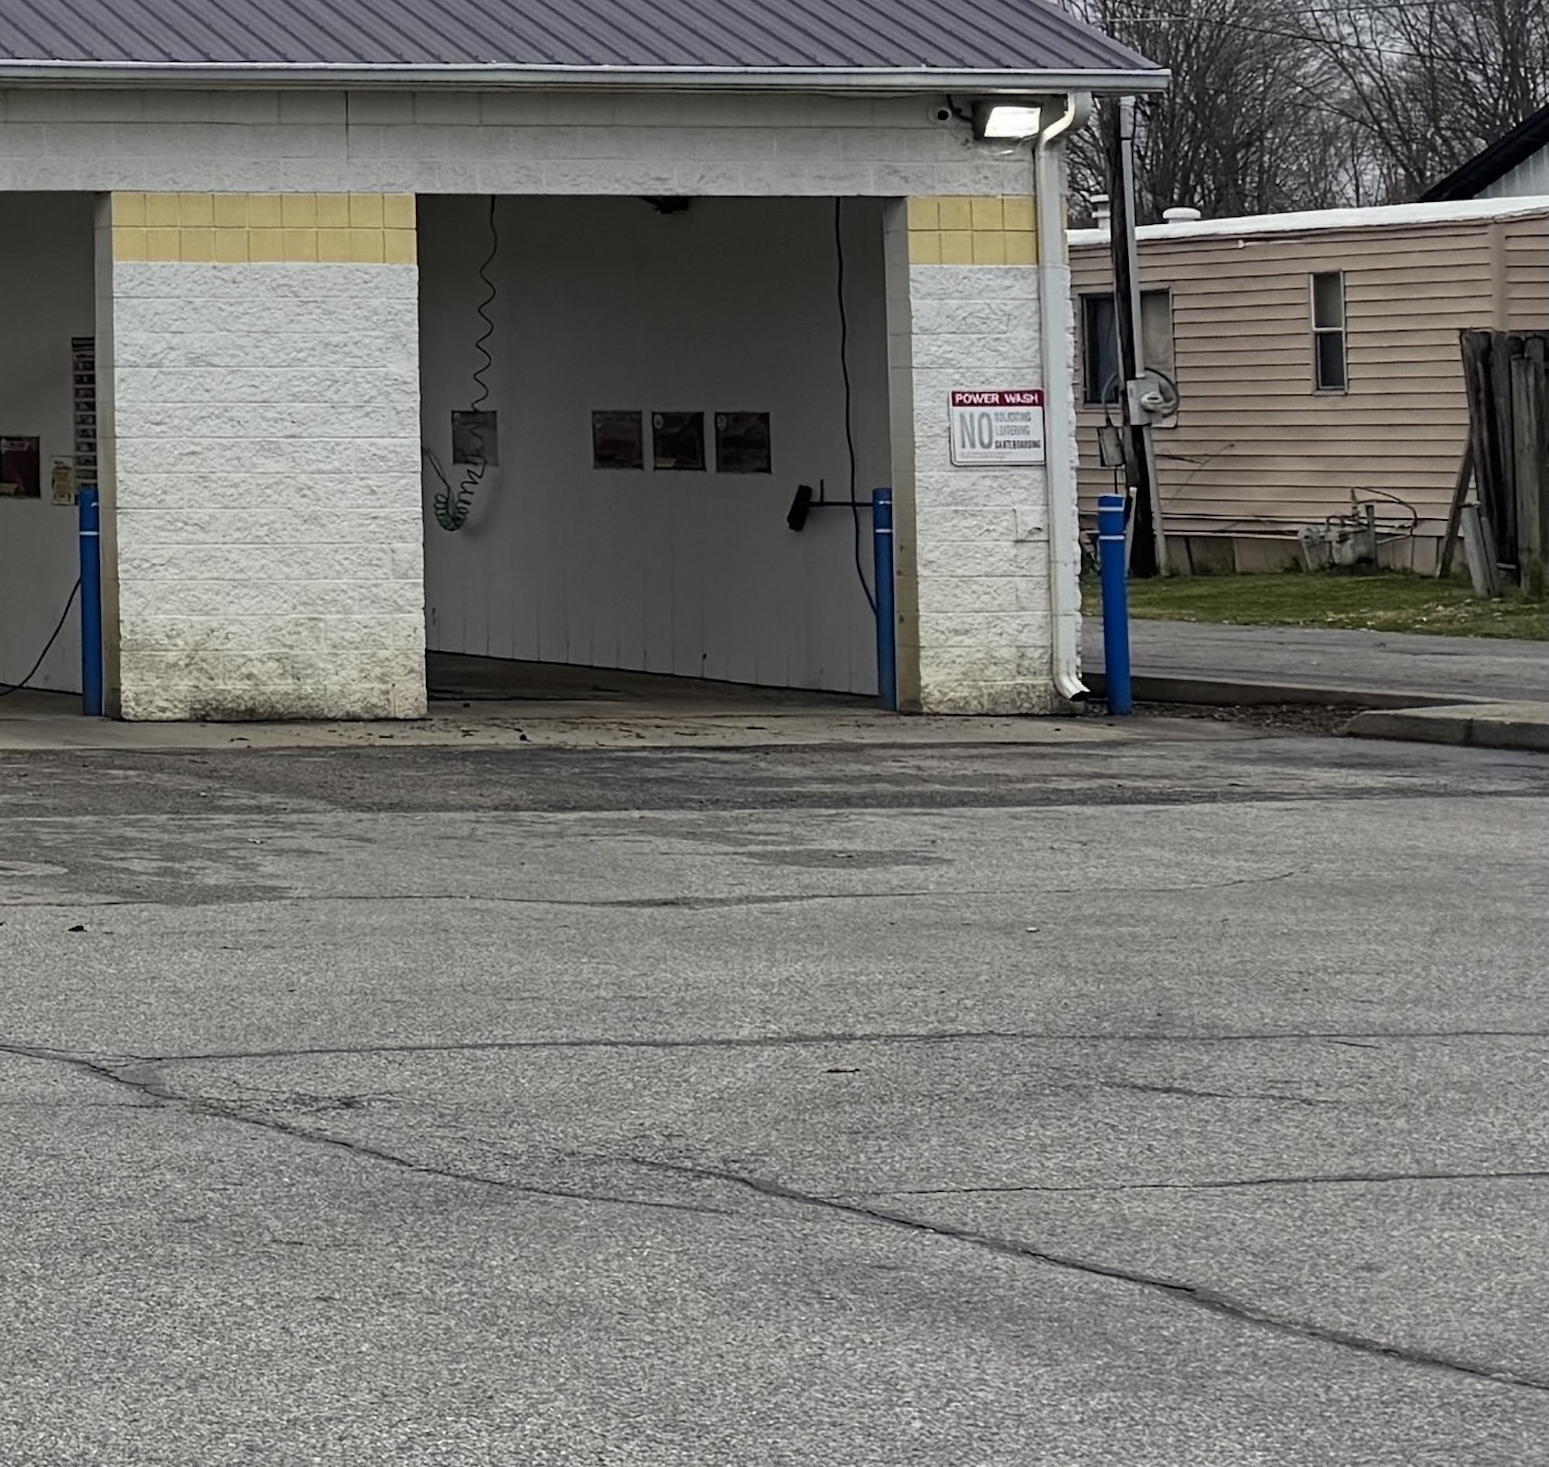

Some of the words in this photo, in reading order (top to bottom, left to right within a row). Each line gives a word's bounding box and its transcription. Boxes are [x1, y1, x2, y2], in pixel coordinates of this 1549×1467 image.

[956, 393, 1000, 404] POWER
[1004, 392, 1039, 404] WASH
[959, 412, 994, 450] NO
